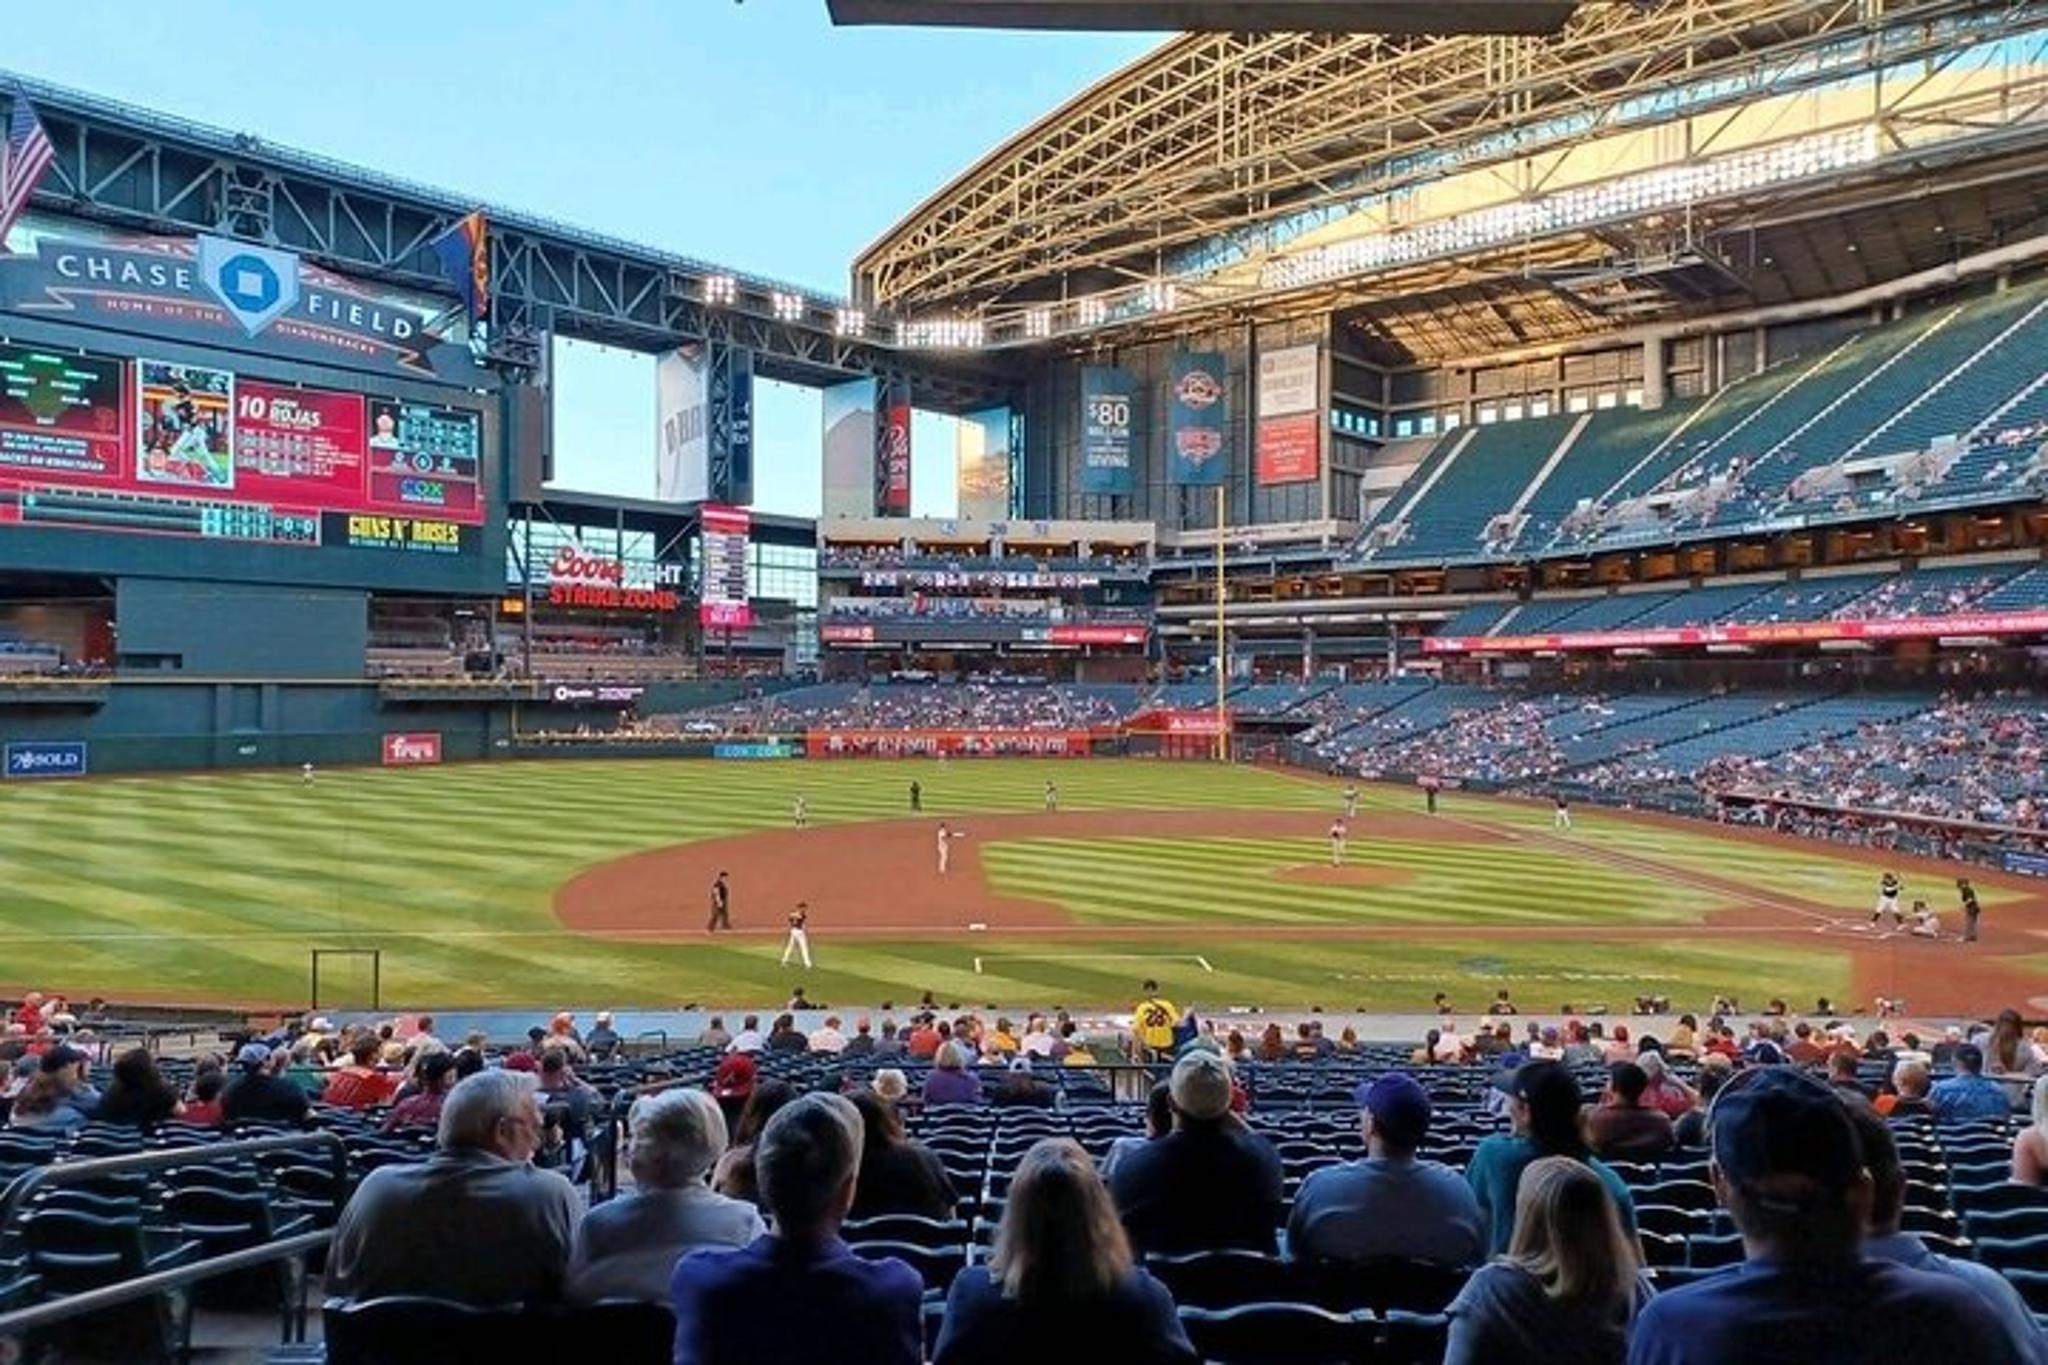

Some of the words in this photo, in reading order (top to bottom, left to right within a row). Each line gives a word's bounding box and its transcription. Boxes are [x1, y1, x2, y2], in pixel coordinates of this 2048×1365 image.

[56, 255, 192, 290] CHASE
[309, 294, 412, 339] FIELD
[107, 300, 153, 312] HOME
[164, 306, 184, 316] OF
[195, 309, 224, 322] THE
[275, 323, 376, 355] DIAMONDBACKS
[239, 396, 266, 419] 10
[270, 406, 321, 428] ROJAS
[1088, 403, 1130, 427] $80
[349, 516, 391, 539] GUNS
[551, 547, 623, 579] Coors
[550, 585, 621, 606] STRIKE
